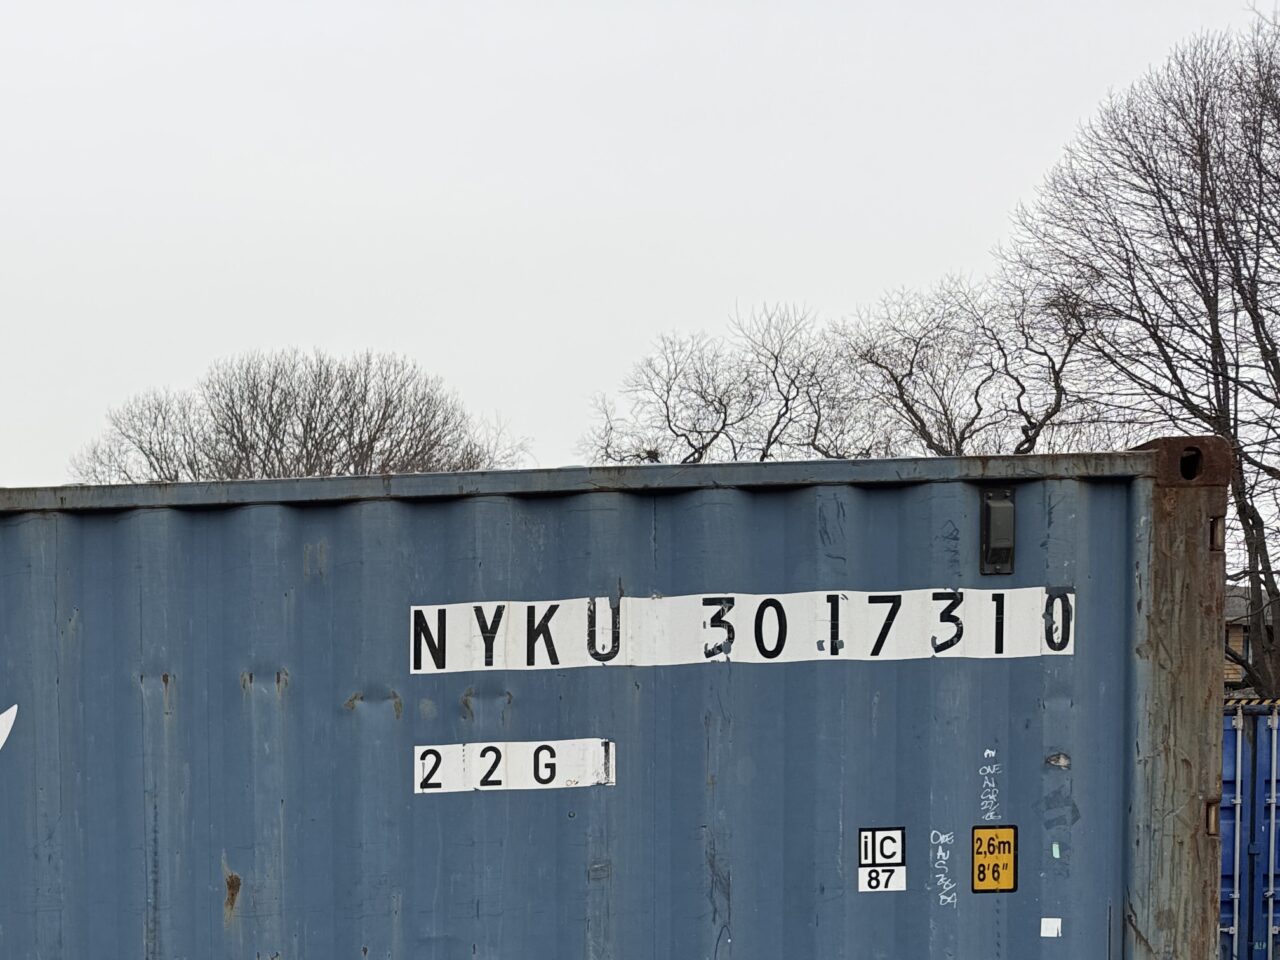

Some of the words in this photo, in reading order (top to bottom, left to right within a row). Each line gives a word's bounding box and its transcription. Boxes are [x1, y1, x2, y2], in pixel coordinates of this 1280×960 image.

[413, 600, 621, 670] NYKU
[702, 592, 1071, 660] 3017310
[867, 869, 895, 889] 87
